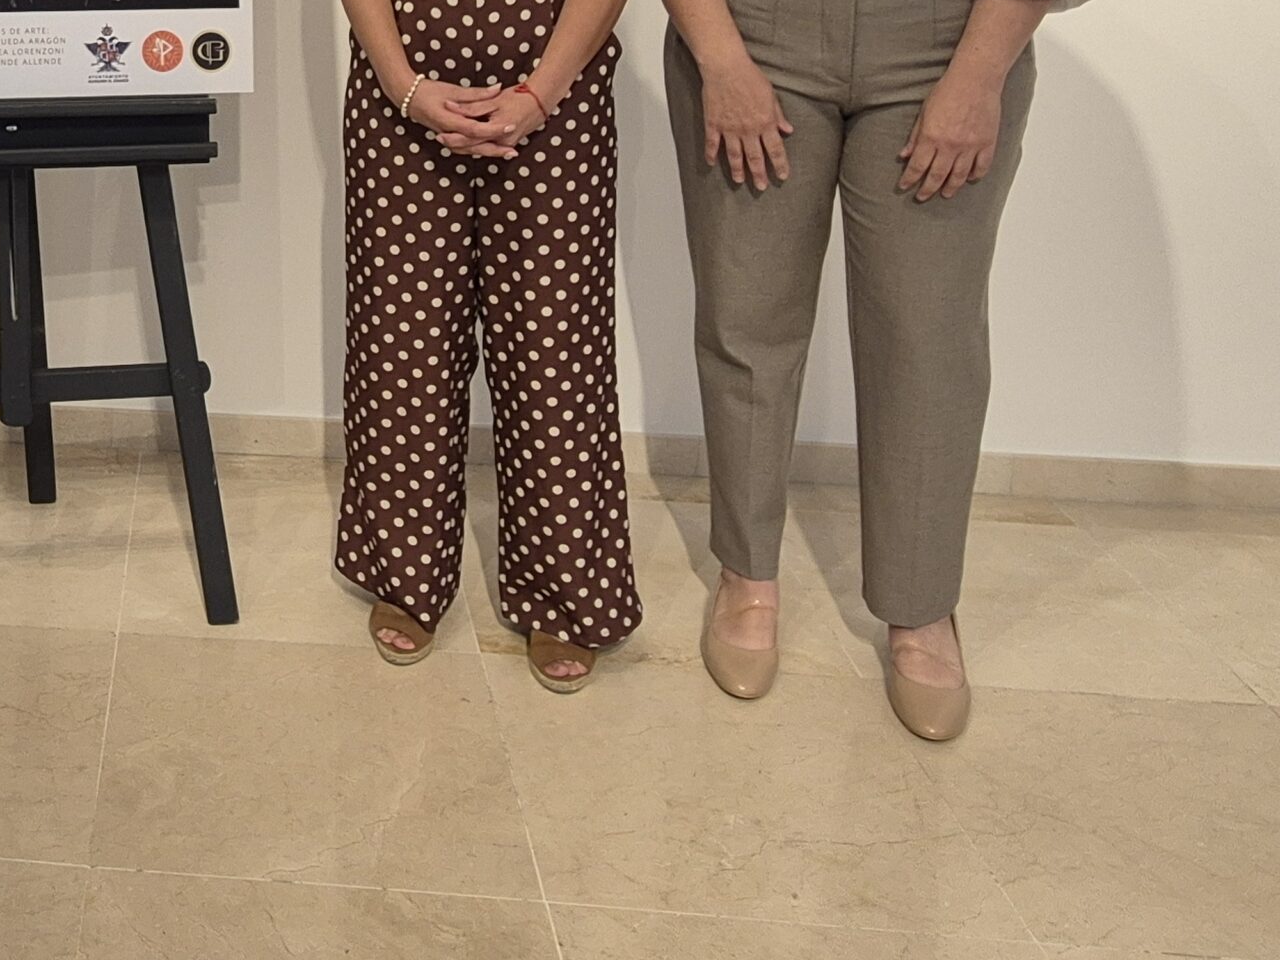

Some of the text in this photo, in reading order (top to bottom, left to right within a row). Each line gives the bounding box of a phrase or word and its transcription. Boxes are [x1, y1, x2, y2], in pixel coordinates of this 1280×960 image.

[9, 27, 21, 36] DE
[24, 26, 50, 36] ARTE:
[29, 36, 67, 46] ARAGÓN
[12, 47, 65, 56] LORENZONI
[22, 57, 63, 66] ALLENDE
